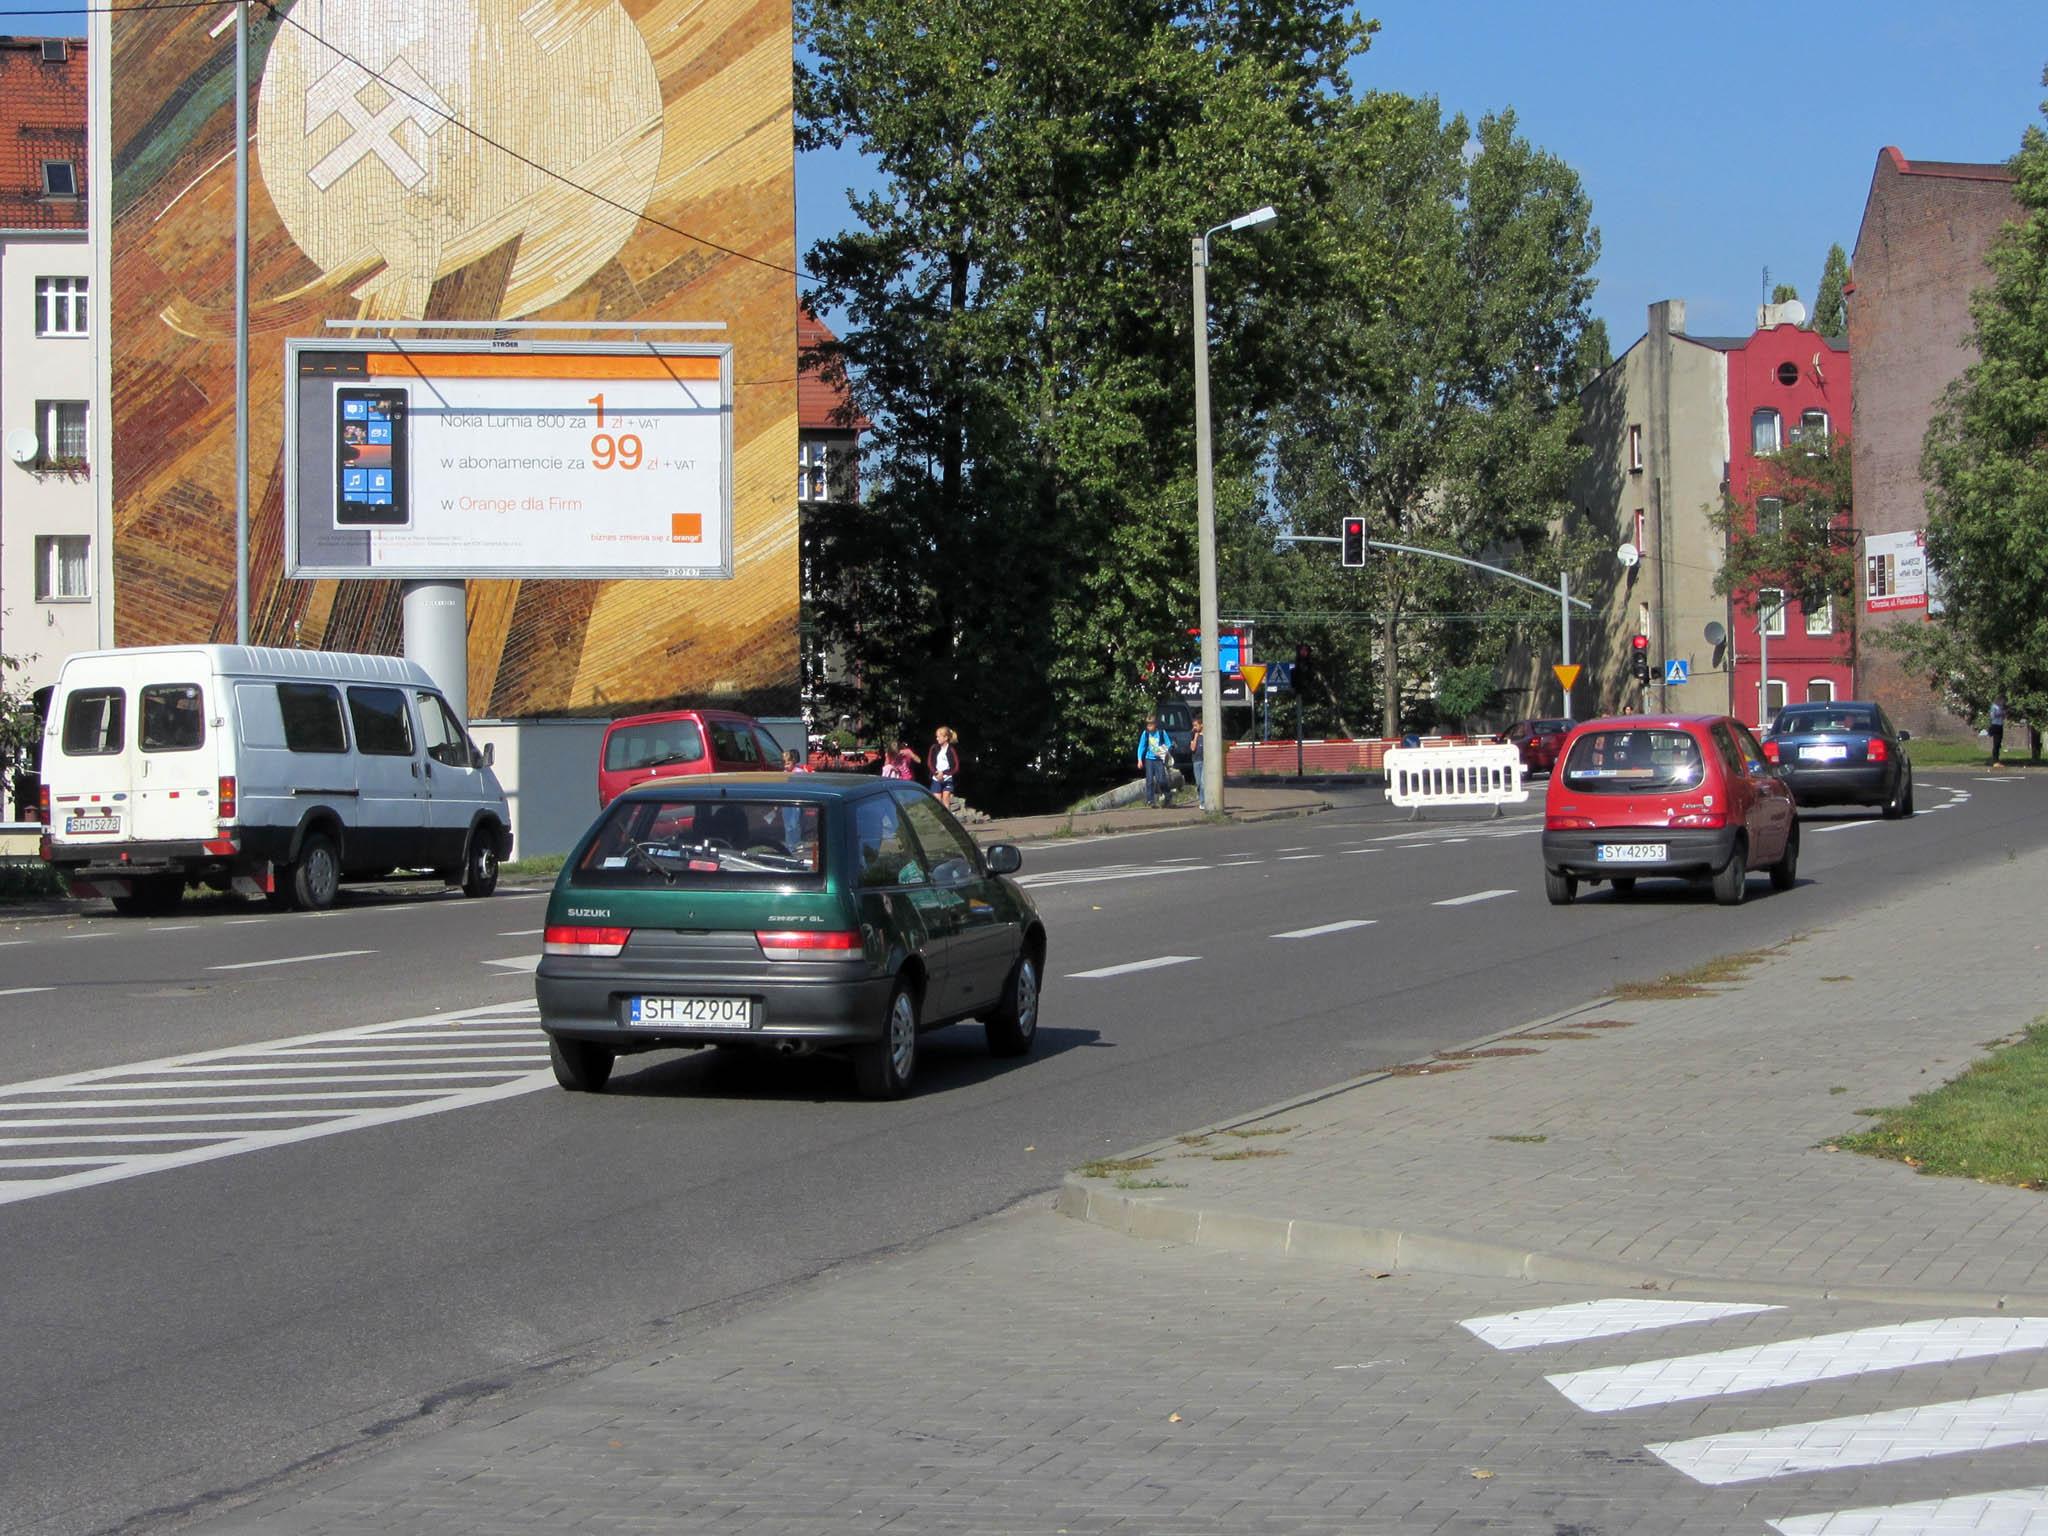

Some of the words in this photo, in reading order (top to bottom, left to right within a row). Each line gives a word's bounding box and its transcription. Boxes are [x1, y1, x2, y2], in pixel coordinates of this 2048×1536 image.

[440, 413, 483, 429] Nokia
[487, 414, 532, 429] Lumia
[536, 414, 565, 429] 800
[569, 418, 587, 429] za
[588, 393, 604, 429] 1
[611, 416, 623, 429] zł
[637, 419, 660, 429] VAT
[440, 458, 454, 469] w
[458, 455, 563, 470] abonamencie
[567, 458, 585, 470] za
[590, 433, 643, 471] 99
[646, 458, 659, 470] zł
[674, 460, 696, 471] VAT
[440, 499, 454, 510] w
[458, 496, 518, 513] Orange
[521, 496, 544, 511] dla
[549, 496, 582, 511] Firm
[673, 535, 701, 543] orange
[72, 819, 87, 831] SH
[1605, 845, 1622, 858] SY
[1627, 845, 1665, 858] 42953
[567, 908, 611, 918] SUZUKI
[644, 998, 675, 1020] SH
[682, 998, 747, 1021] 42904
